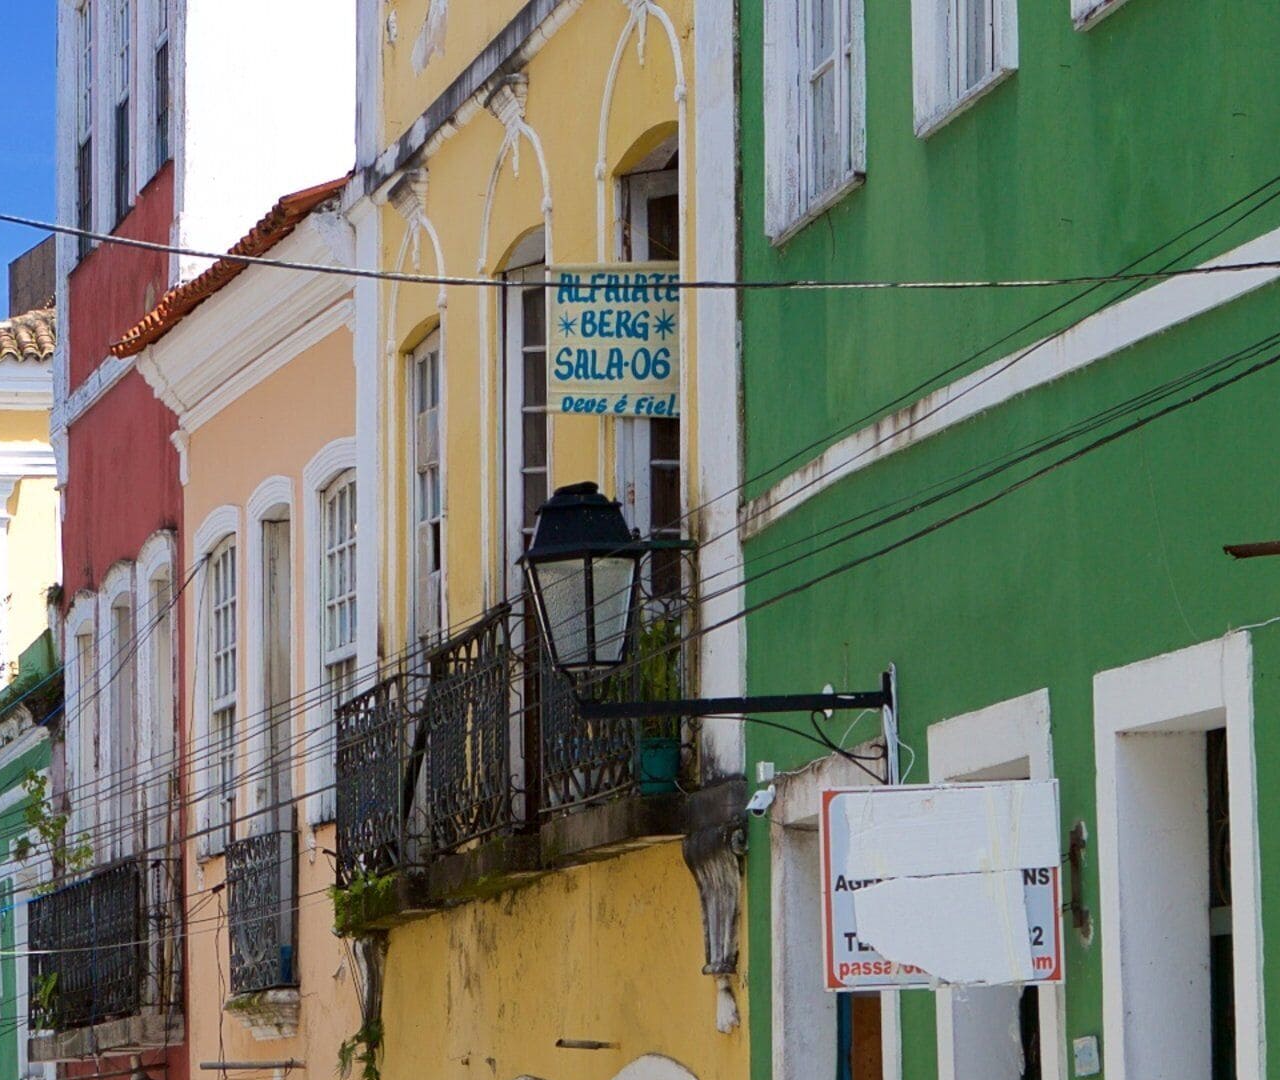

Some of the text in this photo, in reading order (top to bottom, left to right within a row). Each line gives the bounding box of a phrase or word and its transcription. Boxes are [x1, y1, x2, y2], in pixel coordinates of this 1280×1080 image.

[557, 273, 680, 304] ALFAIATE
[581, 309, 650, 341] BERG
[614, 394, 627, 413] é
